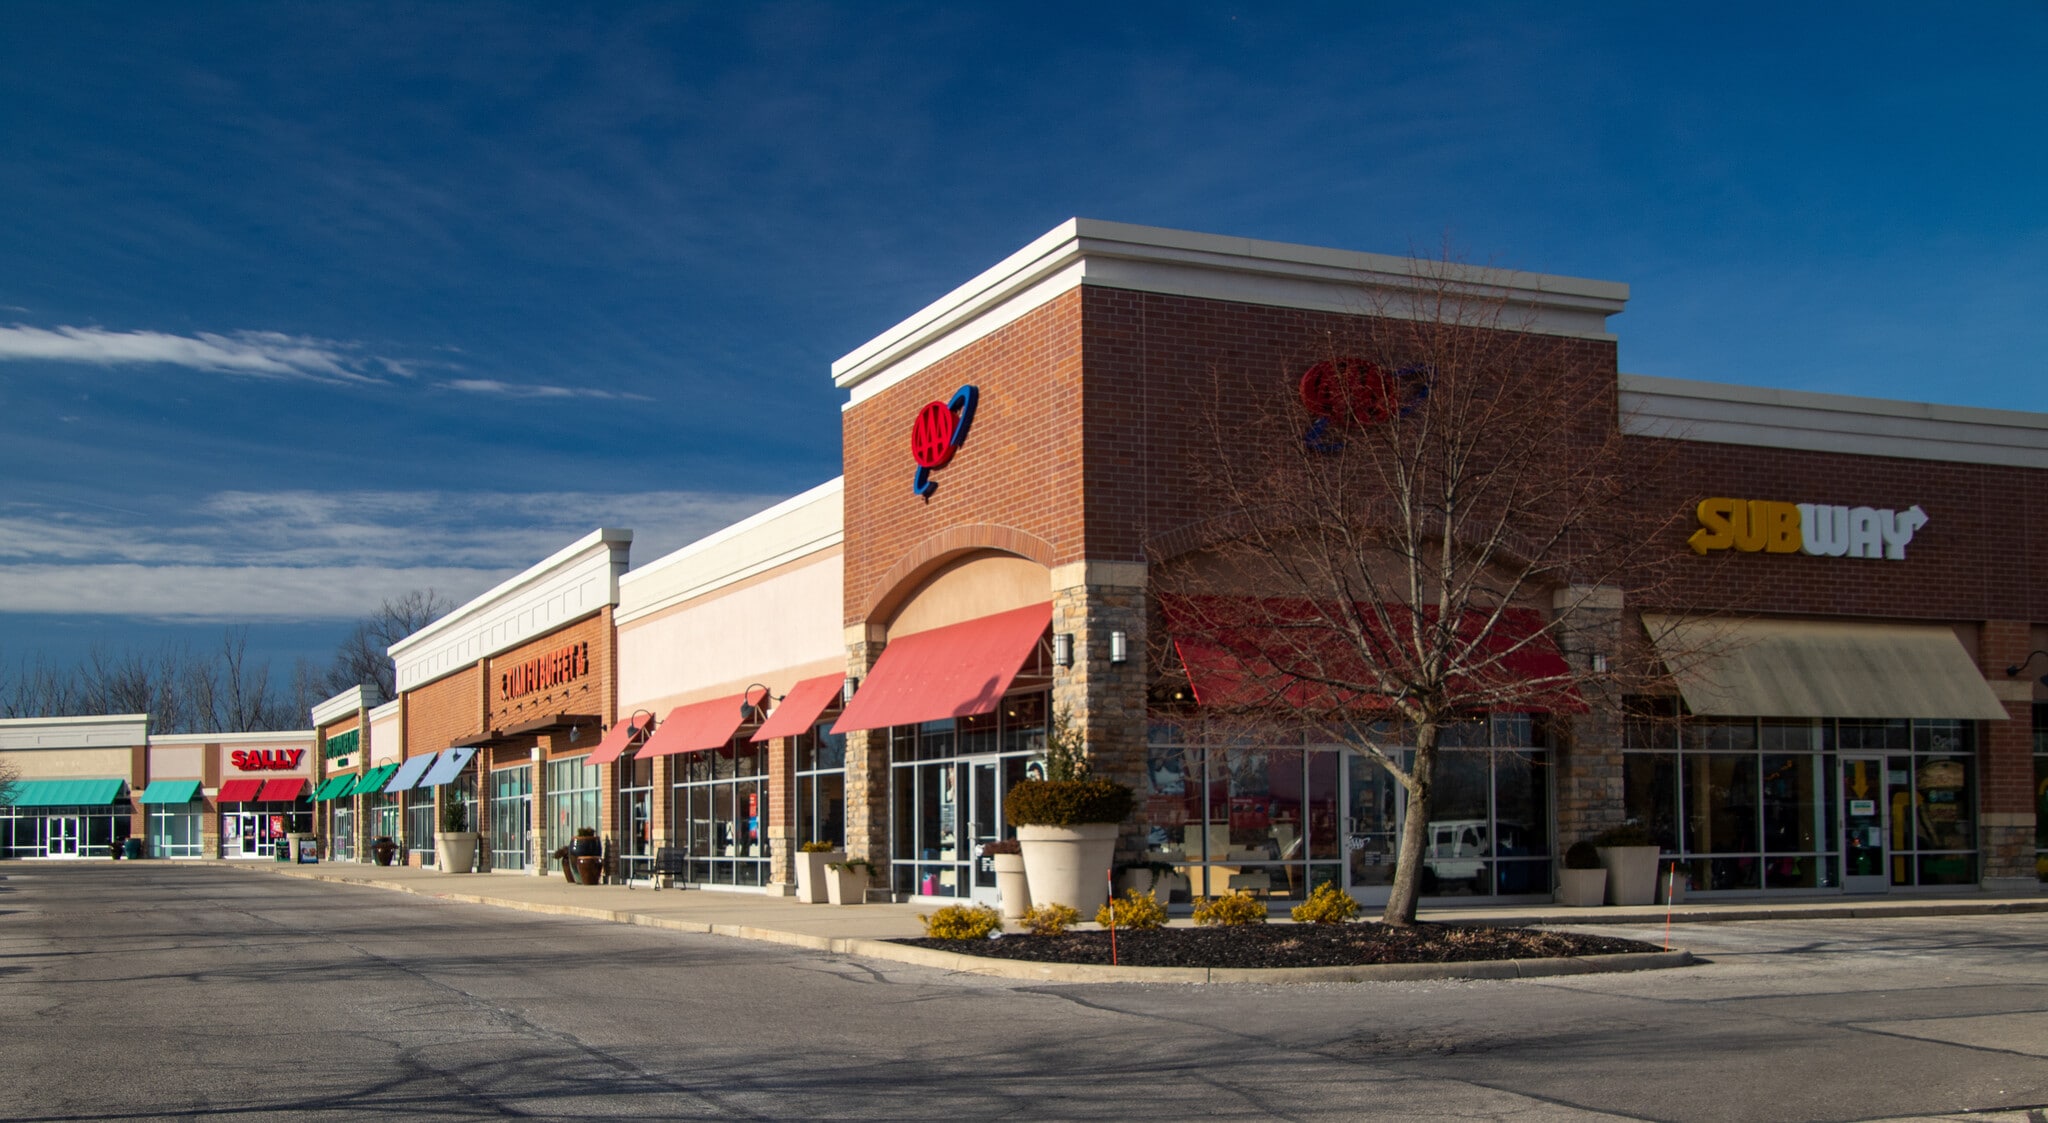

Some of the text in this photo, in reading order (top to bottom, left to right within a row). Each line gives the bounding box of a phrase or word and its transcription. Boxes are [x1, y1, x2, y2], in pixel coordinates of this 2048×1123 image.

[912, 401, 952, 466] AAA
[1687, 497, 1929, 560] SUBWAY
[540, 645, 577, 688] BUFFET
[231, 748, 303, 767] SALLY
